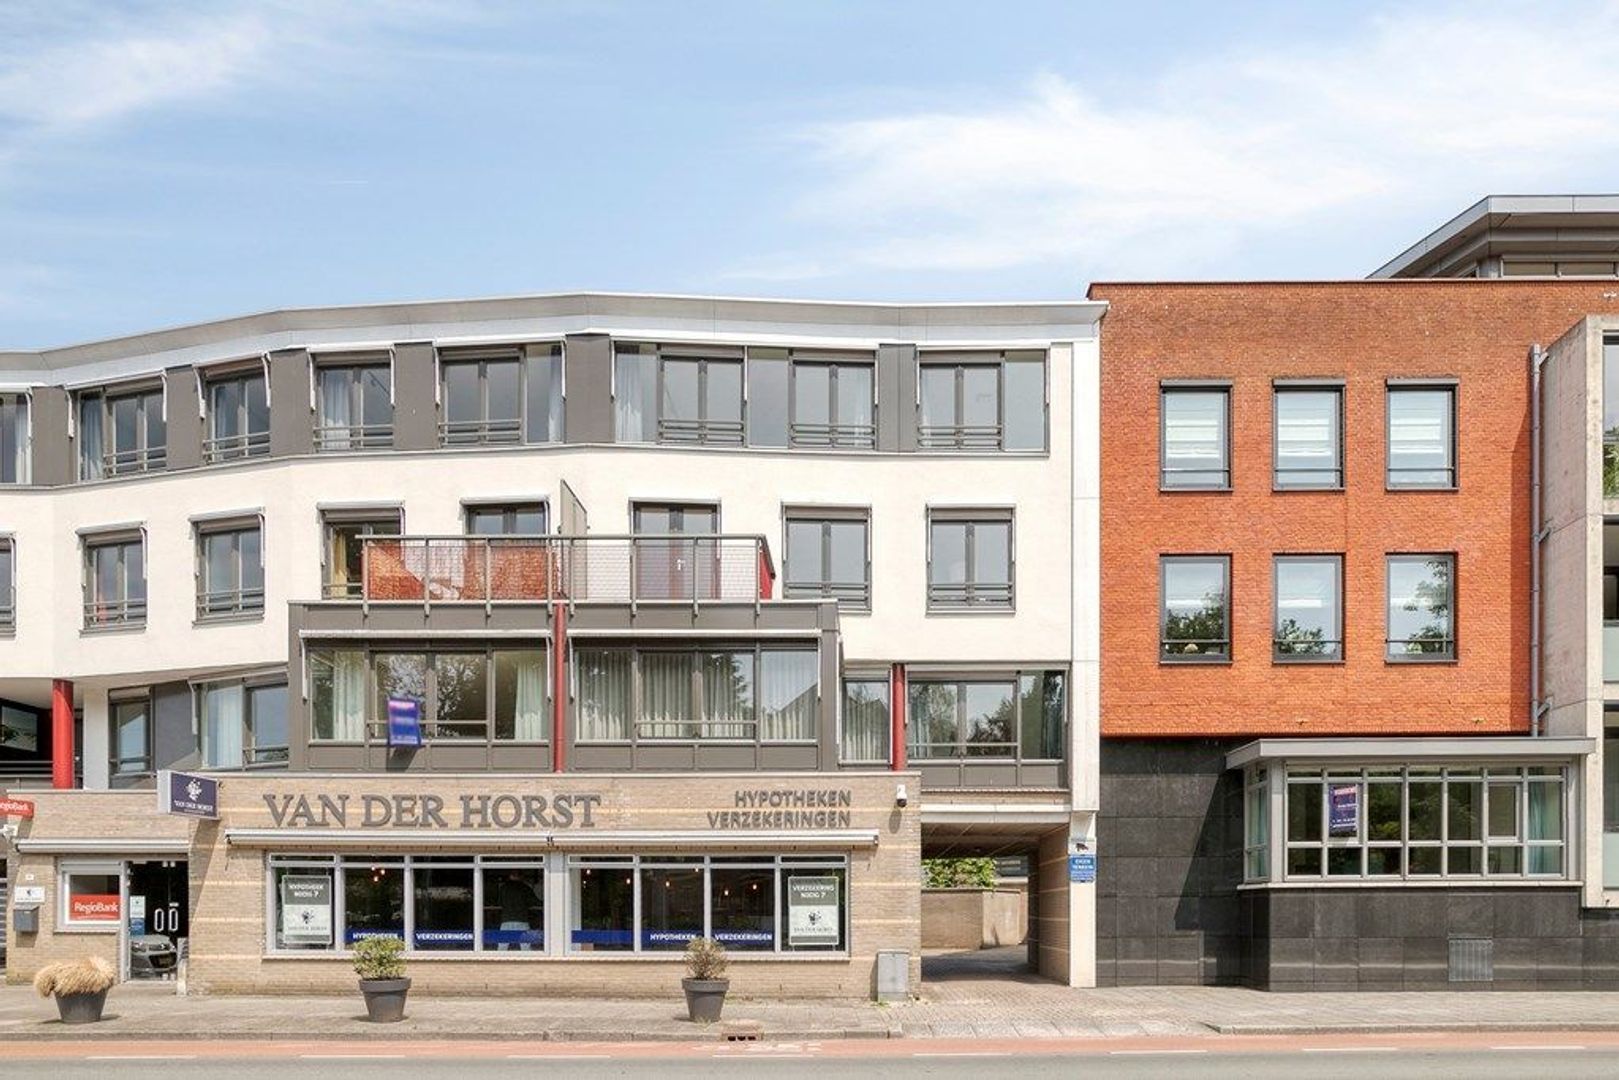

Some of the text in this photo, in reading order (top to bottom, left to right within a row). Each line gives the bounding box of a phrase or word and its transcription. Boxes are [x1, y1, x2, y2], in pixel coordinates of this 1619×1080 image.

[735, 790, 851, 808] HYPOTHEKEN
[0, 801, 29, 812] egioBank
[263, 794, 601, 828] VAN DER HORST
[707, 810, 851, 828] VERZEKERINGEN
[74, 901, 119, 915] RegioBank
[415, 932, 474, 940] VERZEKERINGEN
[714, 933, 773, 941] VERZEKERINGEN
